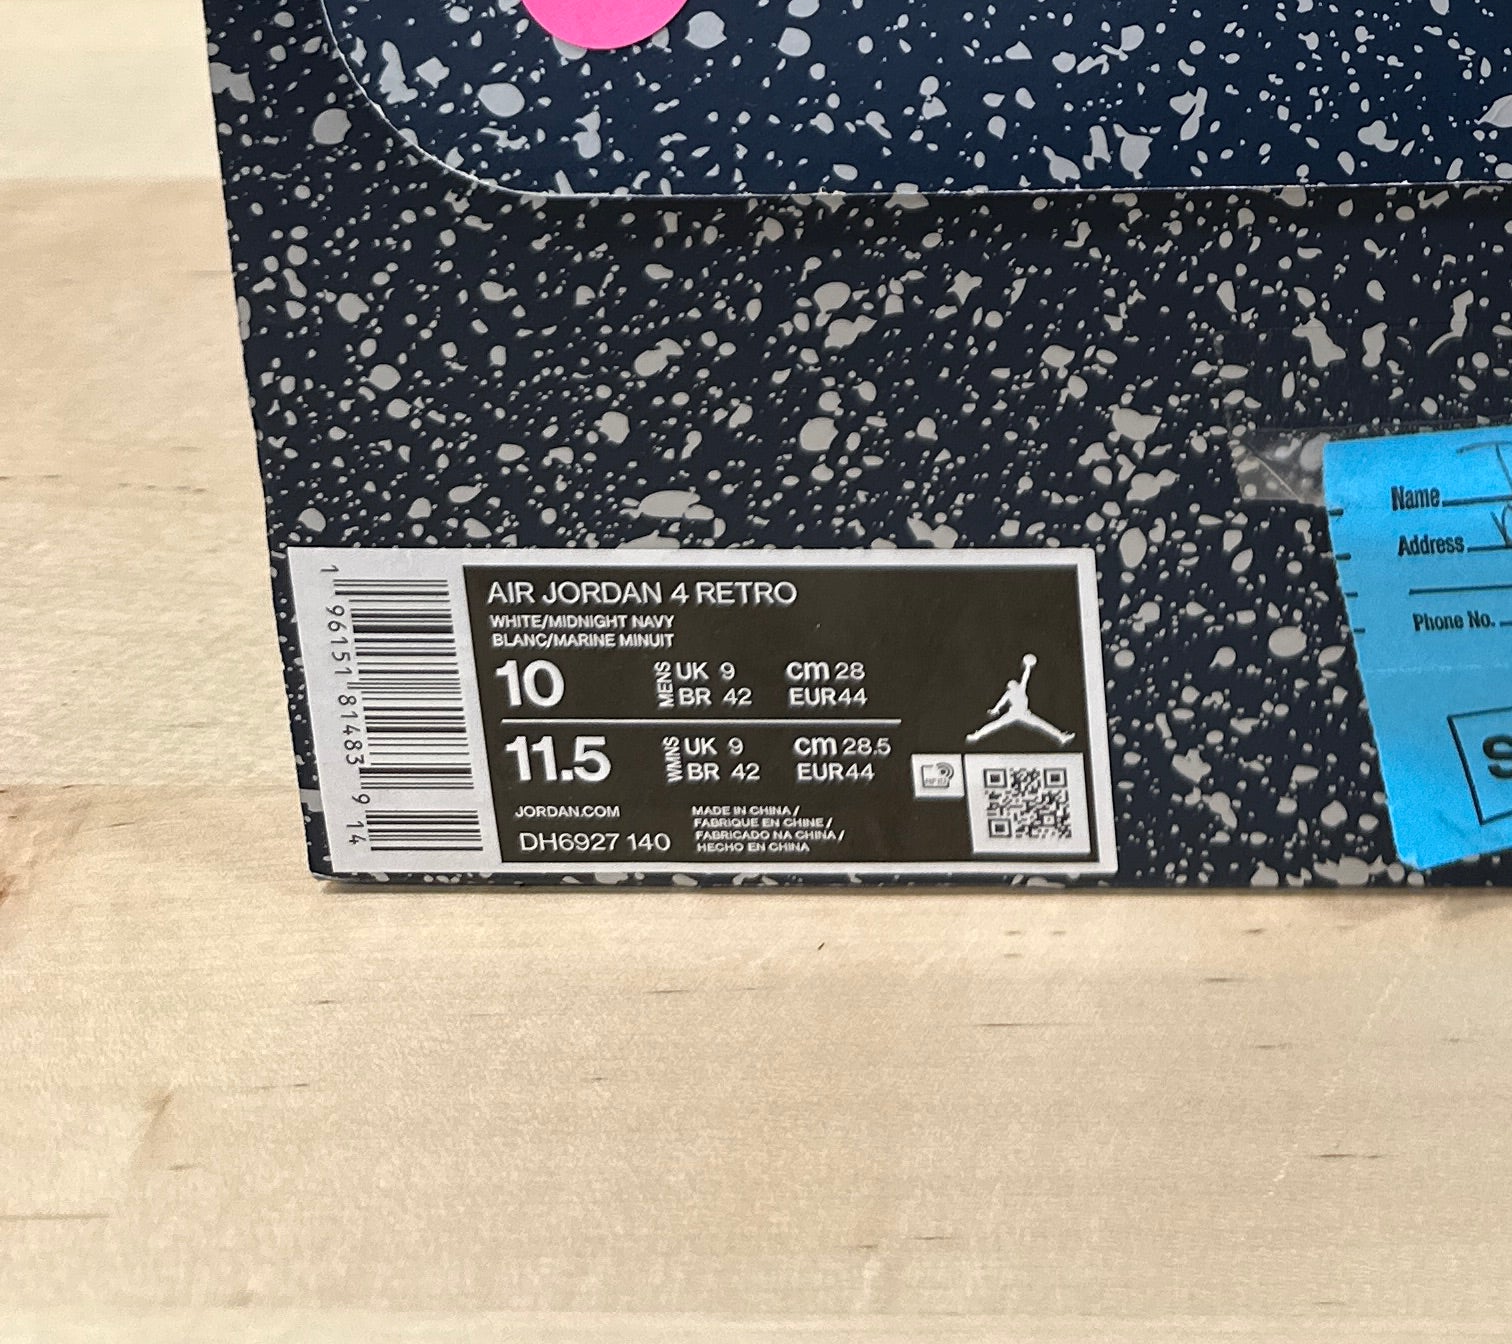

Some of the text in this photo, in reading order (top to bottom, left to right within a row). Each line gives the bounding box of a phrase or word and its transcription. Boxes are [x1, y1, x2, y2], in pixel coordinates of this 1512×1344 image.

[1391, 486, 1440, 511] Name
[1398, 534, 1465, 556] Address
[487, 581, 798, 605] AIR JORDAN 4 RETRO
[489, 614, 675, 629] WHITE/MIDNIGHT NAVY
[1412, 611, 1496, 631] Phone No.
[492, 633, 675, 648] BLANC/MARINE MINUIT
[676, 662, 736, 680] UK 9
[786, 662, 866, 680] cm 28
[495, 659, 565, 708] 10
[654, 661, 674, 708] MENS
[678, 688, 752, 706] BR 42
[337, 694, 366, 766] 81483
[684, 737, 744, 755] UK 9
[794, 737, 892, 755] cm 28.5
[505, 735, 612, 782] 11.5
[662, 736, 683, 783] WMNS
[687, 763, 760, 781] BR 42
[515, 805, 622, 818] JORDAN.COM
[691, 805, 731, 816] MADE
[733, 805, 747, 816] IN
[694, 817, 759, 828] FABRIQUE
[761, 817, 780, 828] EN
[519, 832, 672, 852] DH6927 140
[695, 830, 770, 840] FABRICADO
[773, 830, 793, 840] NA
[697, 842, 810, 852] HECHO EN CHINA
